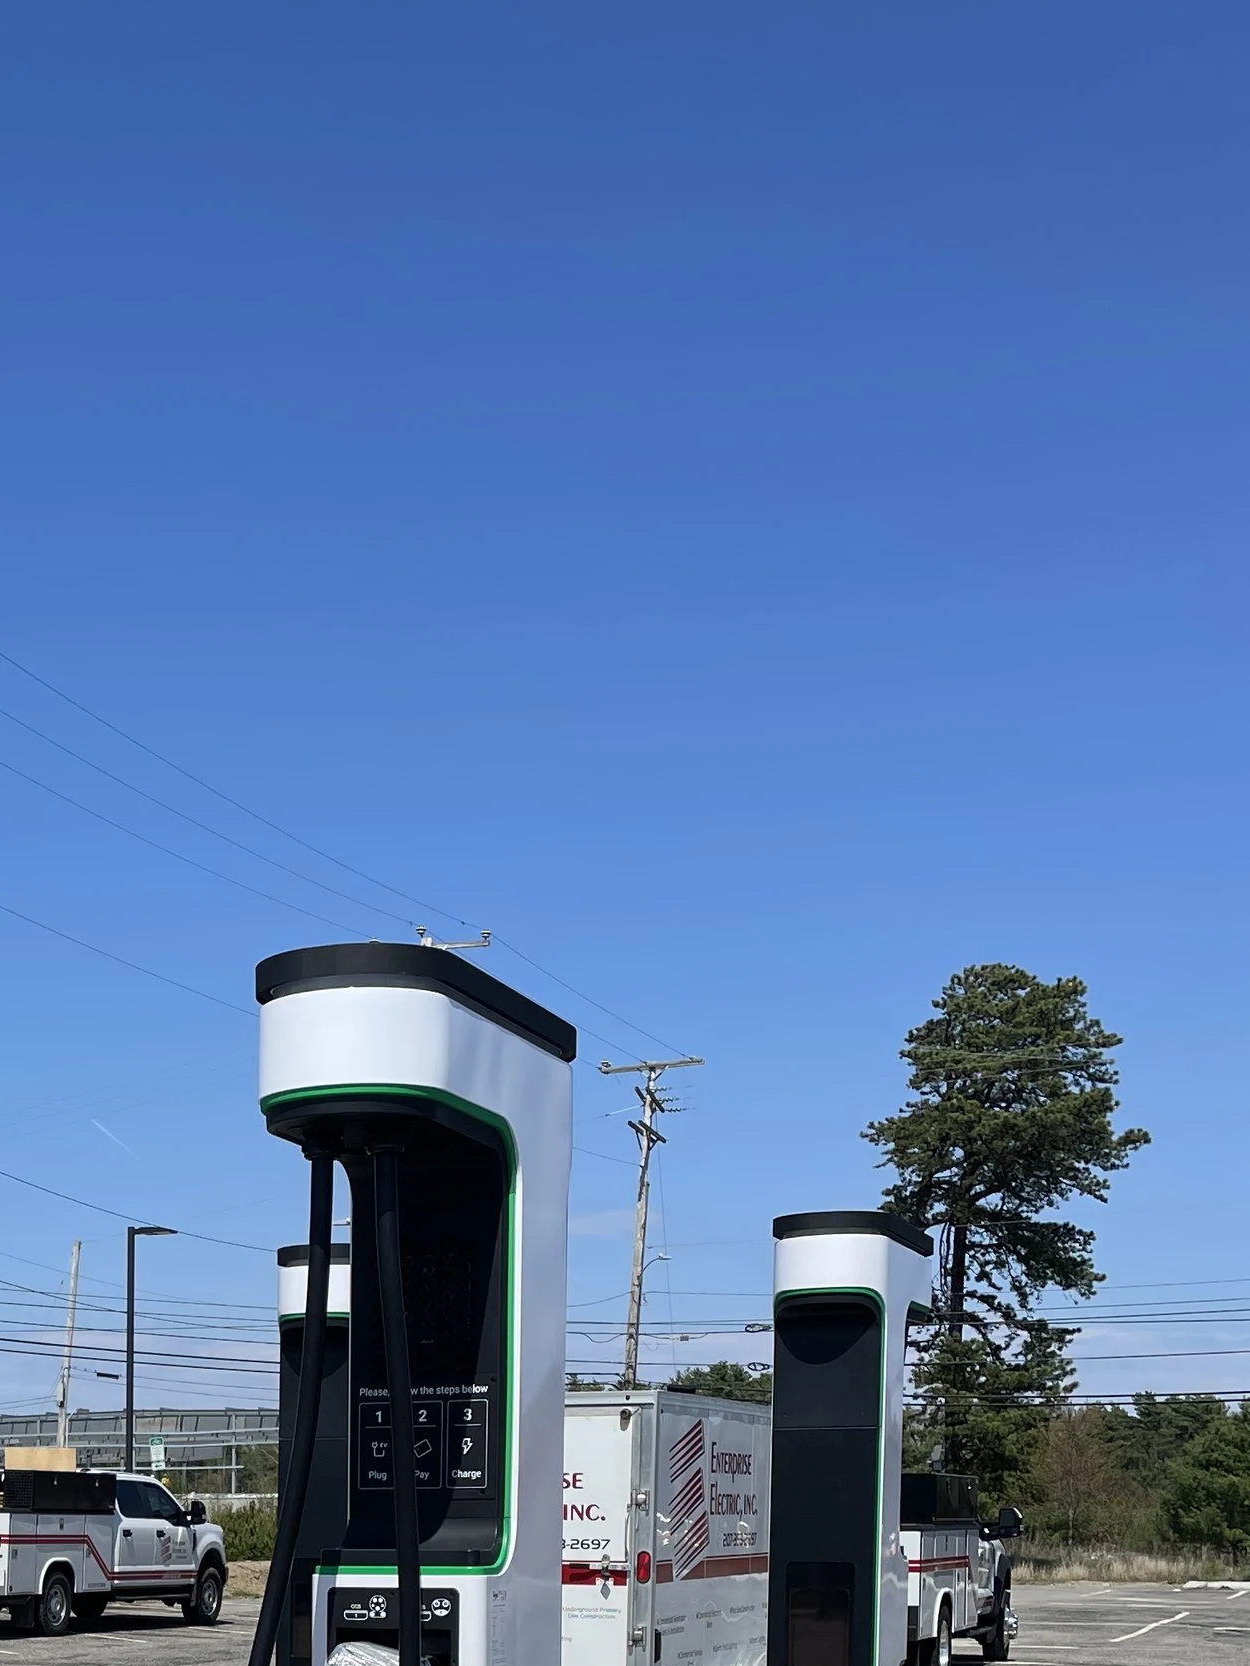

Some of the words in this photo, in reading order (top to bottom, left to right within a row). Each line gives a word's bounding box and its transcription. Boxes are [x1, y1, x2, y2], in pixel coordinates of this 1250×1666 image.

[420, 1386, 434, 1395] the
[436, 1385, 460, 1396] steps
[461, 1384, 489, 1394] below
[376, 1410, 382, 1423] 1
[418, 1409, 427, 1422] 2
[463, 1408, 472, 1421] 3
[369, 1470, 387, 1481] Plug
[452, 1469, 482, 1480] Charge
[563, 1503, 606, 1521] INC.
